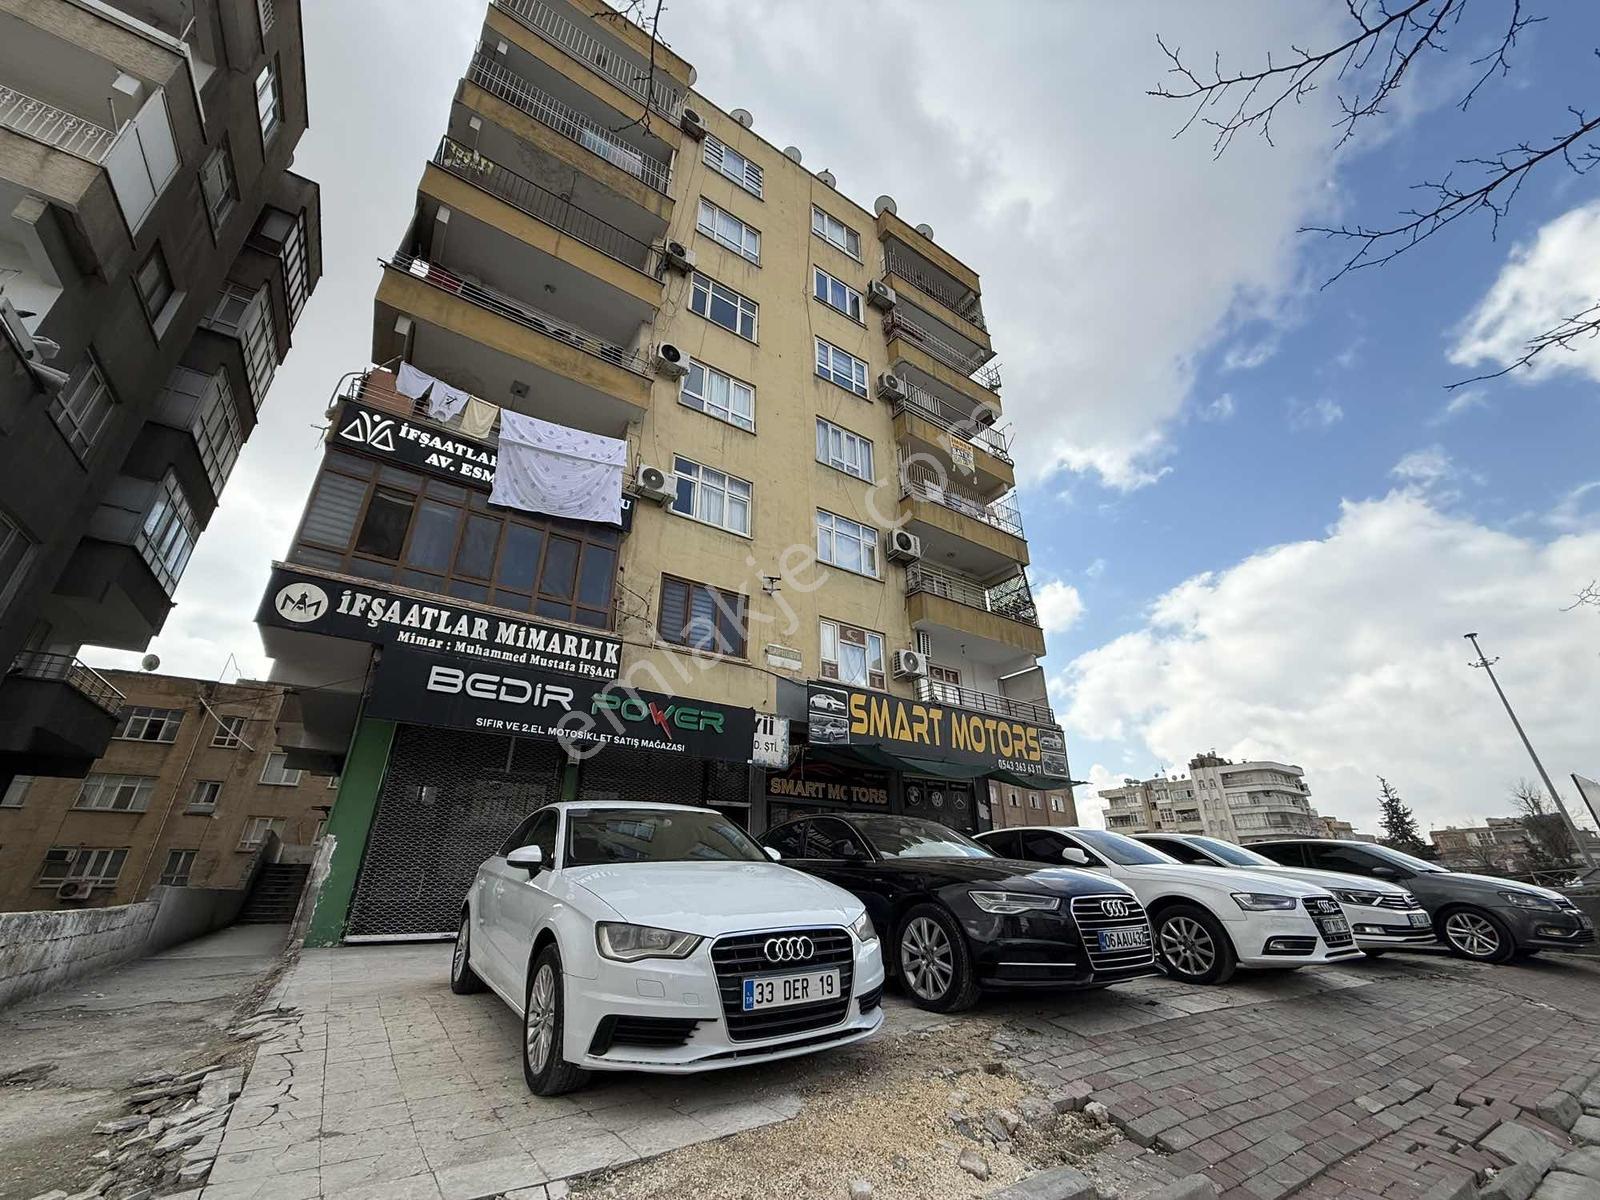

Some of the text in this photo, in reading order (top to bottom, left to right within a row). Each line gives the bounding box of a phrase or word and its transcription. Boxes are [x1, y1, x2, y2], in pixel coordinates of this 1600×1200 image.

[425, 453, 455, 471] AV.
[397, 631, 443, 649] Mimar
[454, 641, 527, 664] Muhammed
[529, 654, 576, 672] Mustafa
[578, 661, 617, 678] İFŞAAT
[591, 693, 725, 737] POWER
[850, 693, 1041, 761] SMART MOTORS
[476, 717, 503, 729] SIFIR
[505, 722, 520, 731] VE
[521, 723, 545, 735] 2.EL
[614, 736, 640, 748] SATIŞ
[641, 739, 685, 752] MAĞAZASI
[770, 777, 826, 798] SMART
[755, 982, 774, 1004] 33
[783, 978, 809, 1001] DER
[819, 974, 834, 996] 19
